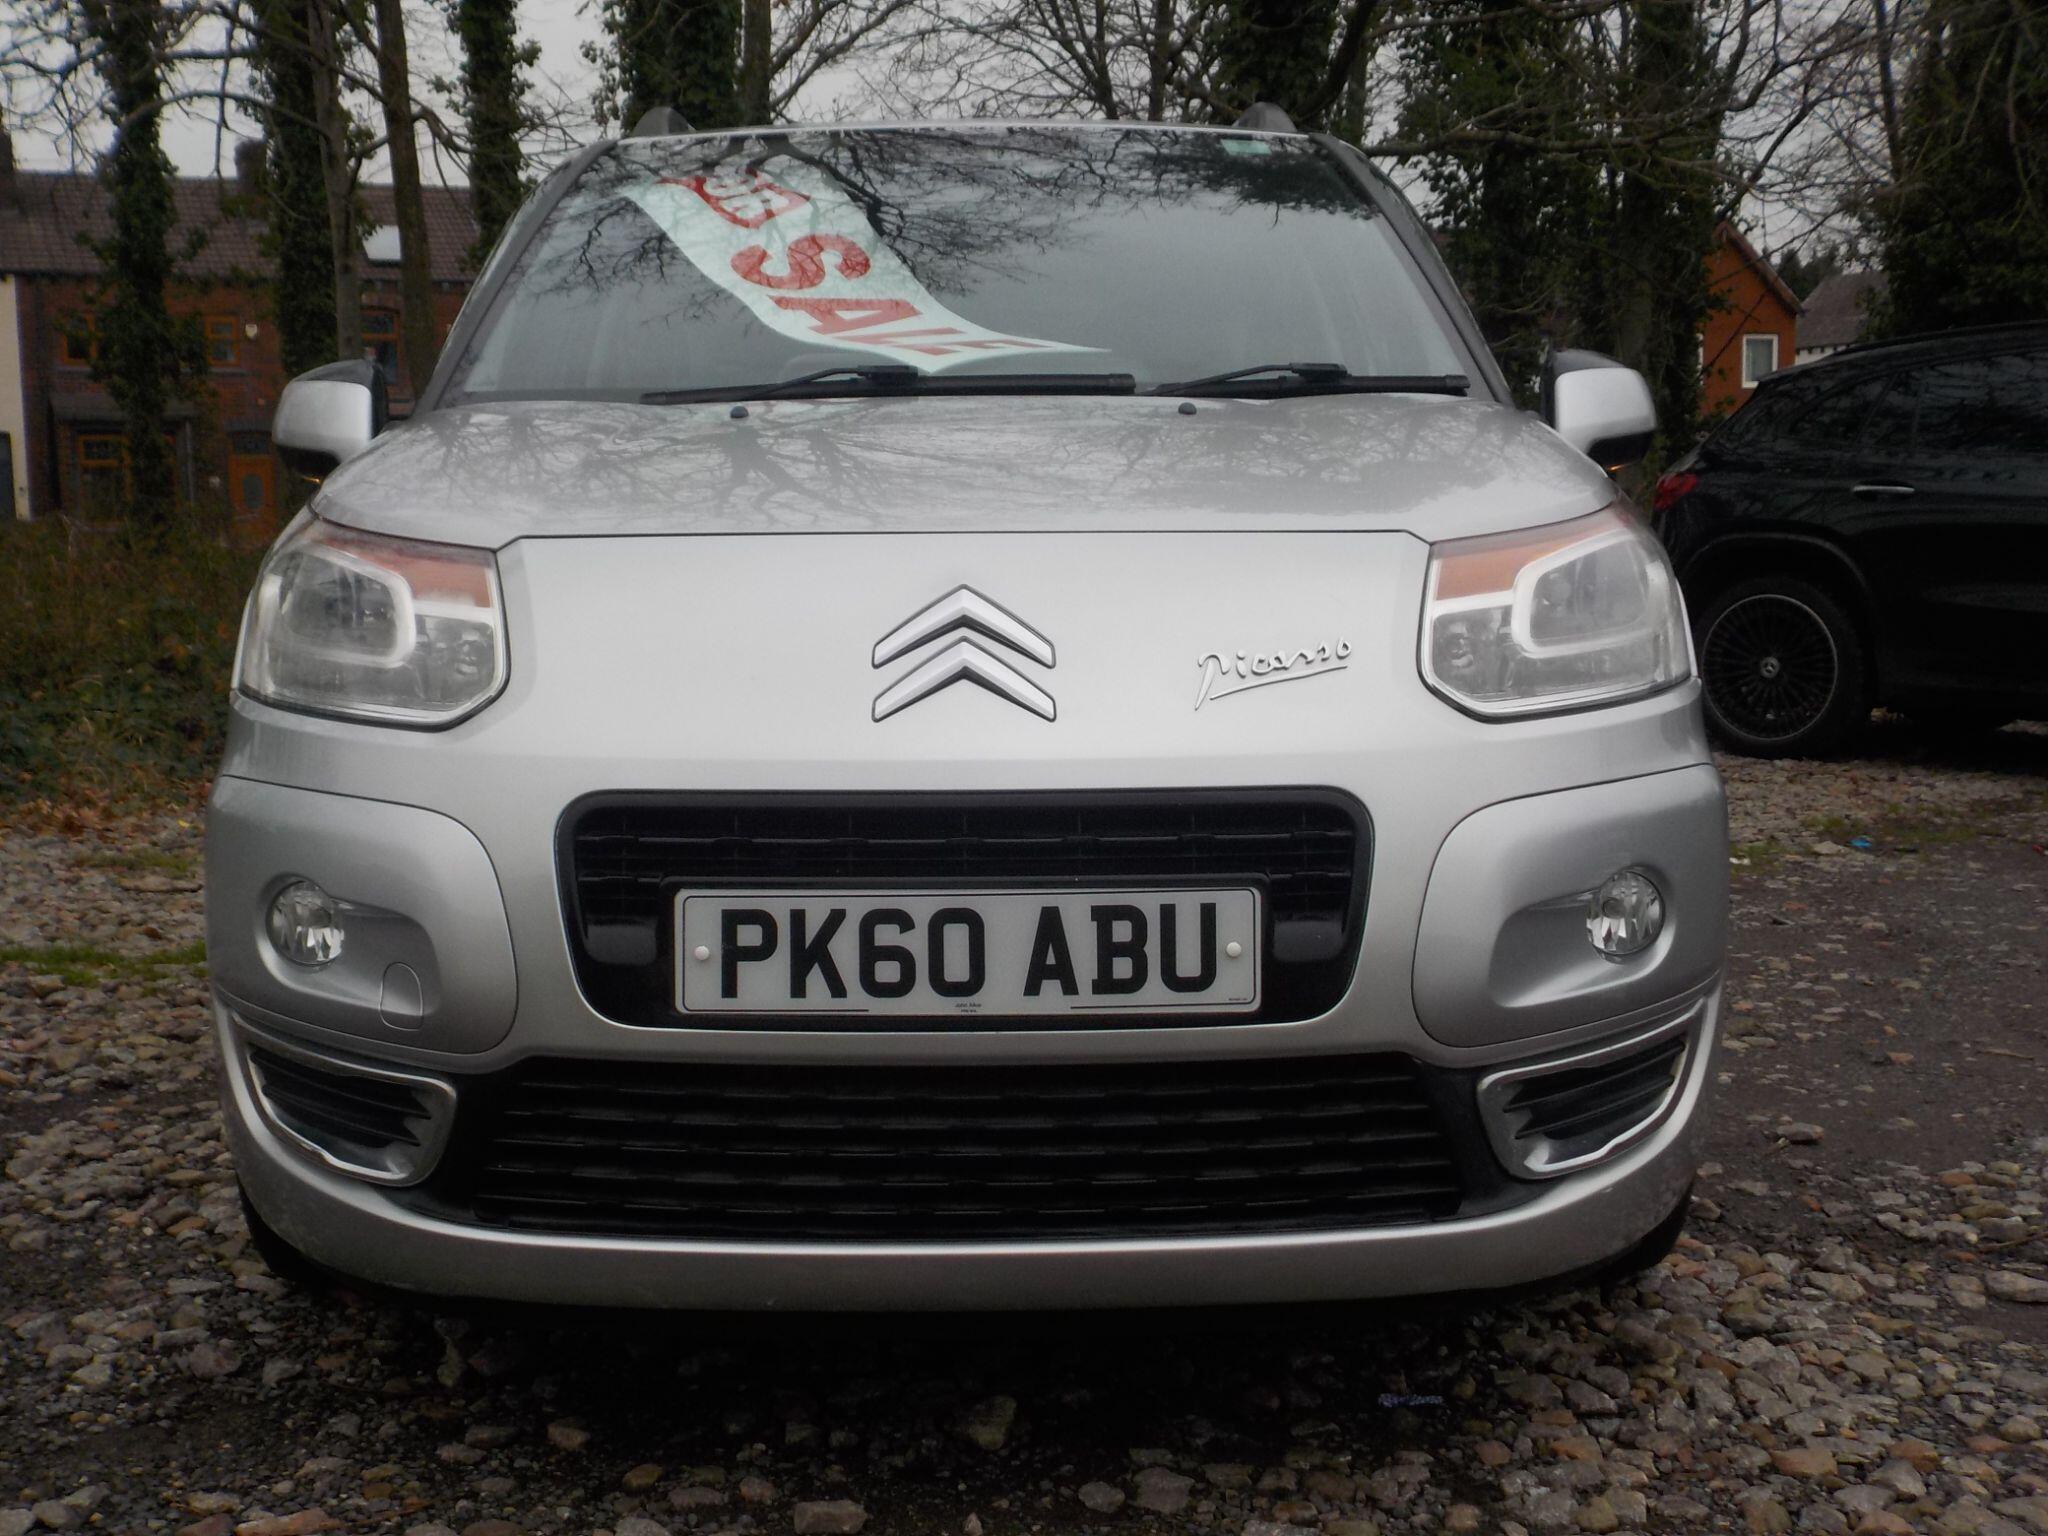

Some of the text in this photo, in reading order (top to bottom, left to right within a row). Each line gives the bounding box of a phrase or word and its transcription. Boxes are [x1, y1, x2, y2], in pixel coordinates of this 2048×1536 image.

[730, 233, 1053, 356] SALE
[1194, 635, 1352, 710] Picasso
[720, 902, 1217, 998] PK60 ABU
